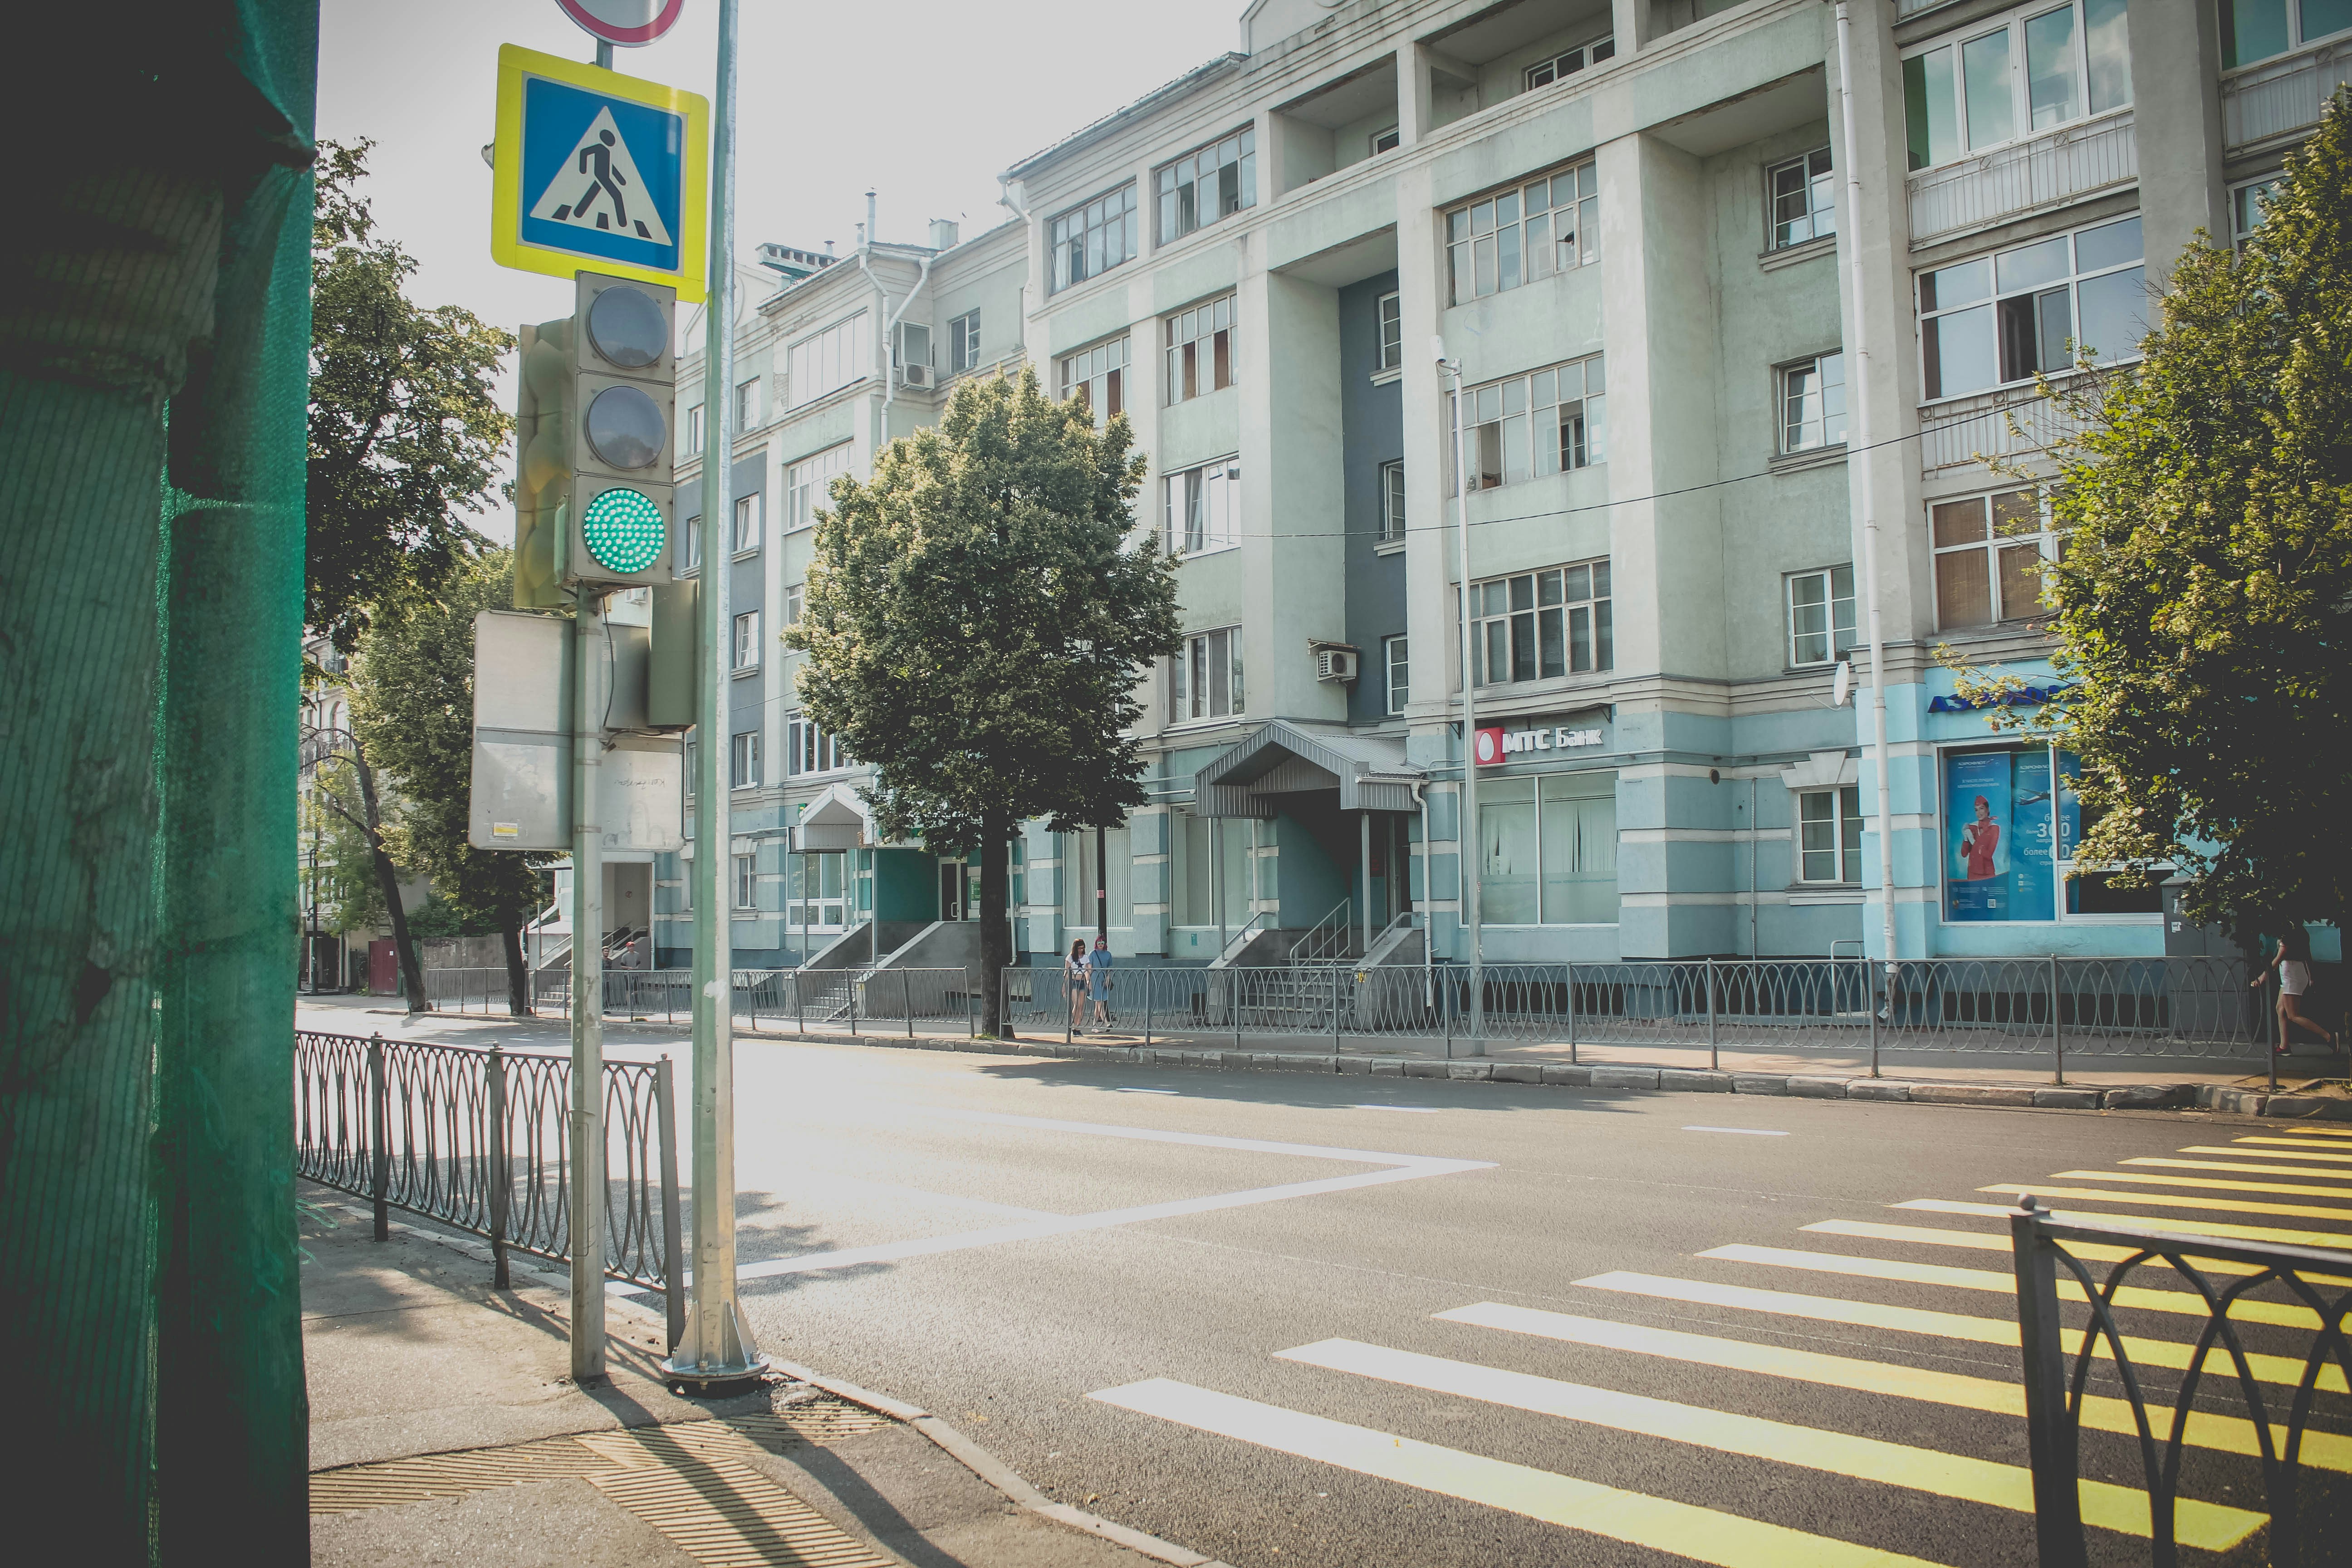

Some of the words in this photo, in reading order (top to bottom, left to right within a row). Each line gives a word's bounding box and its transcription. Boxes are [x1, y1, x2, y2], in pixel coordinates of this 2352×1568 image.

[1502, 729, 1550, 753] МТС
[1556, 727, 1603, 747] Банк
[2024, 848, 2048, 856] более
